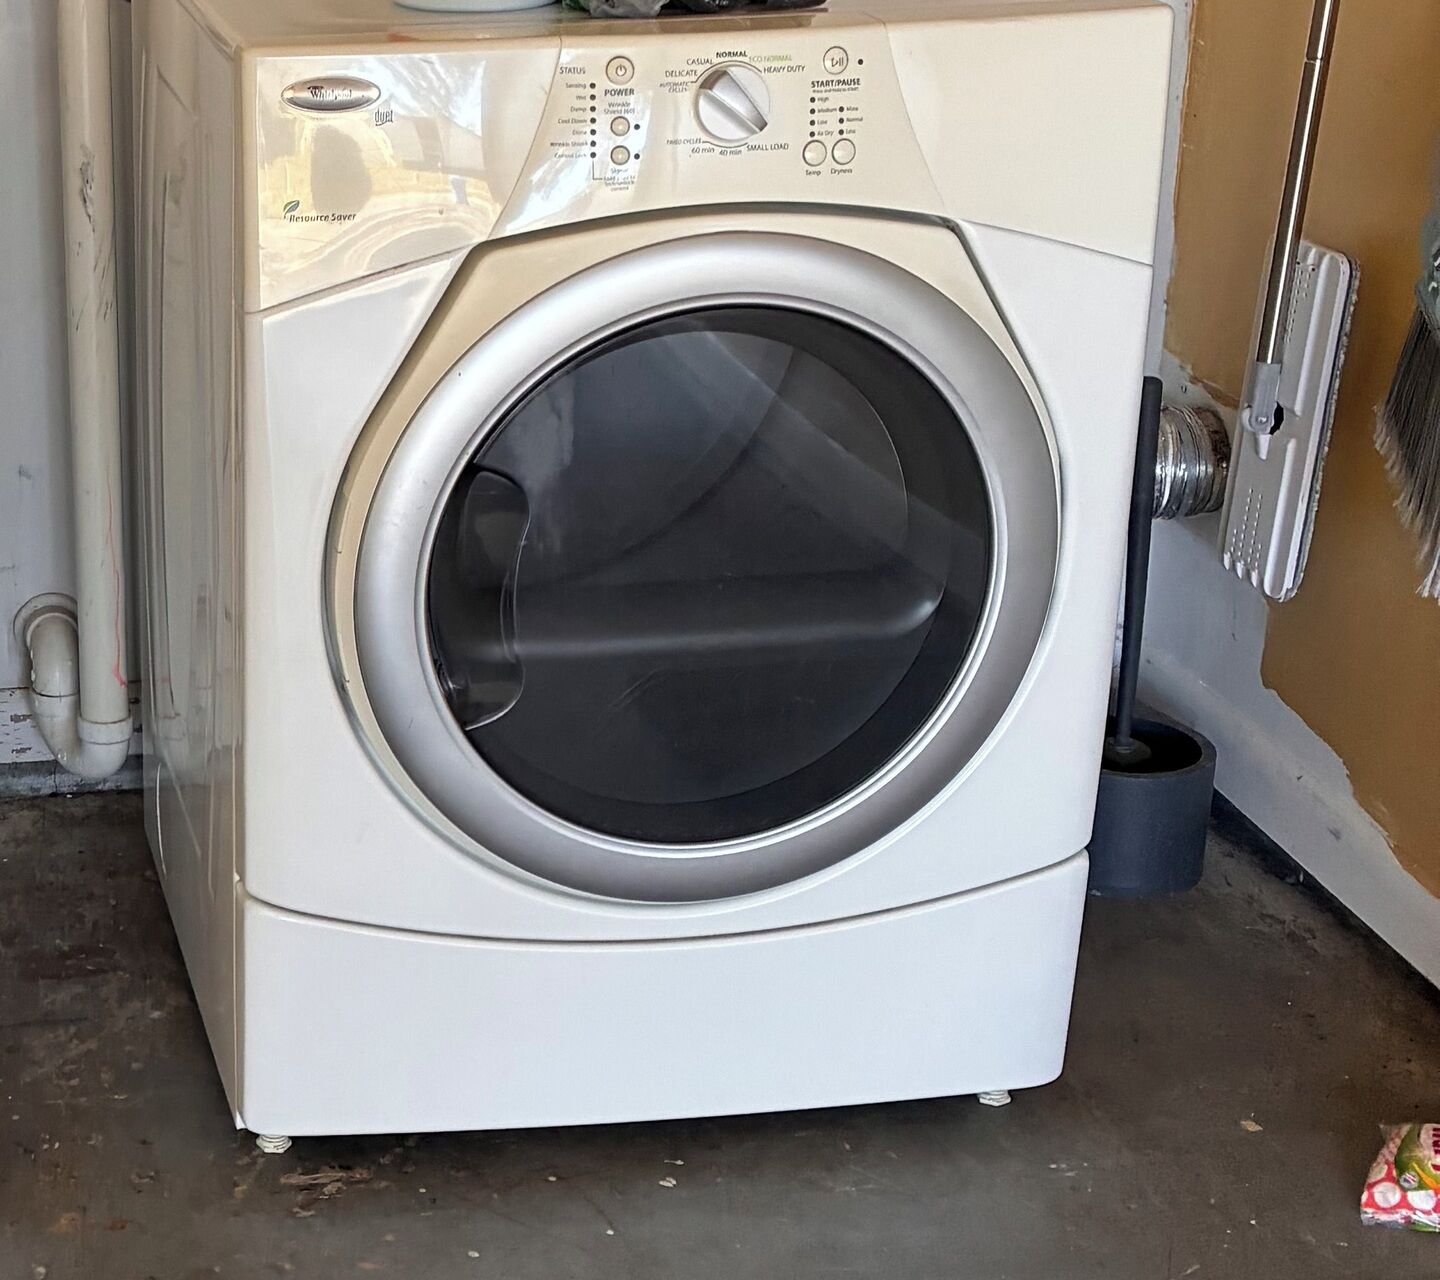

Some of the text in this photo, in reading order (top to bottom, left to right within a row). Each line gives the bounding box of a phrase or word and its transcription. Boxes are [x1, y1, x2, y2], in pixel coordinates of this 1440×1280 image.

[716, 51, 748, 59] NORMAL
[559, 66, 586, 74] STATUS
[665, 70, 698, 78] DELICATE
[763, 66, 786, 74] HEAVY
[811, 78, 861, 88] START/PAUSE
[308, 86, 352, 100] Whirlpool
[604, 88, 635, 97] POWER
[375, 108, 394, 126] duet
[746, 143, 789, 152] SMALL LOAD
[289, 213, 356, 223] Resource Saver
